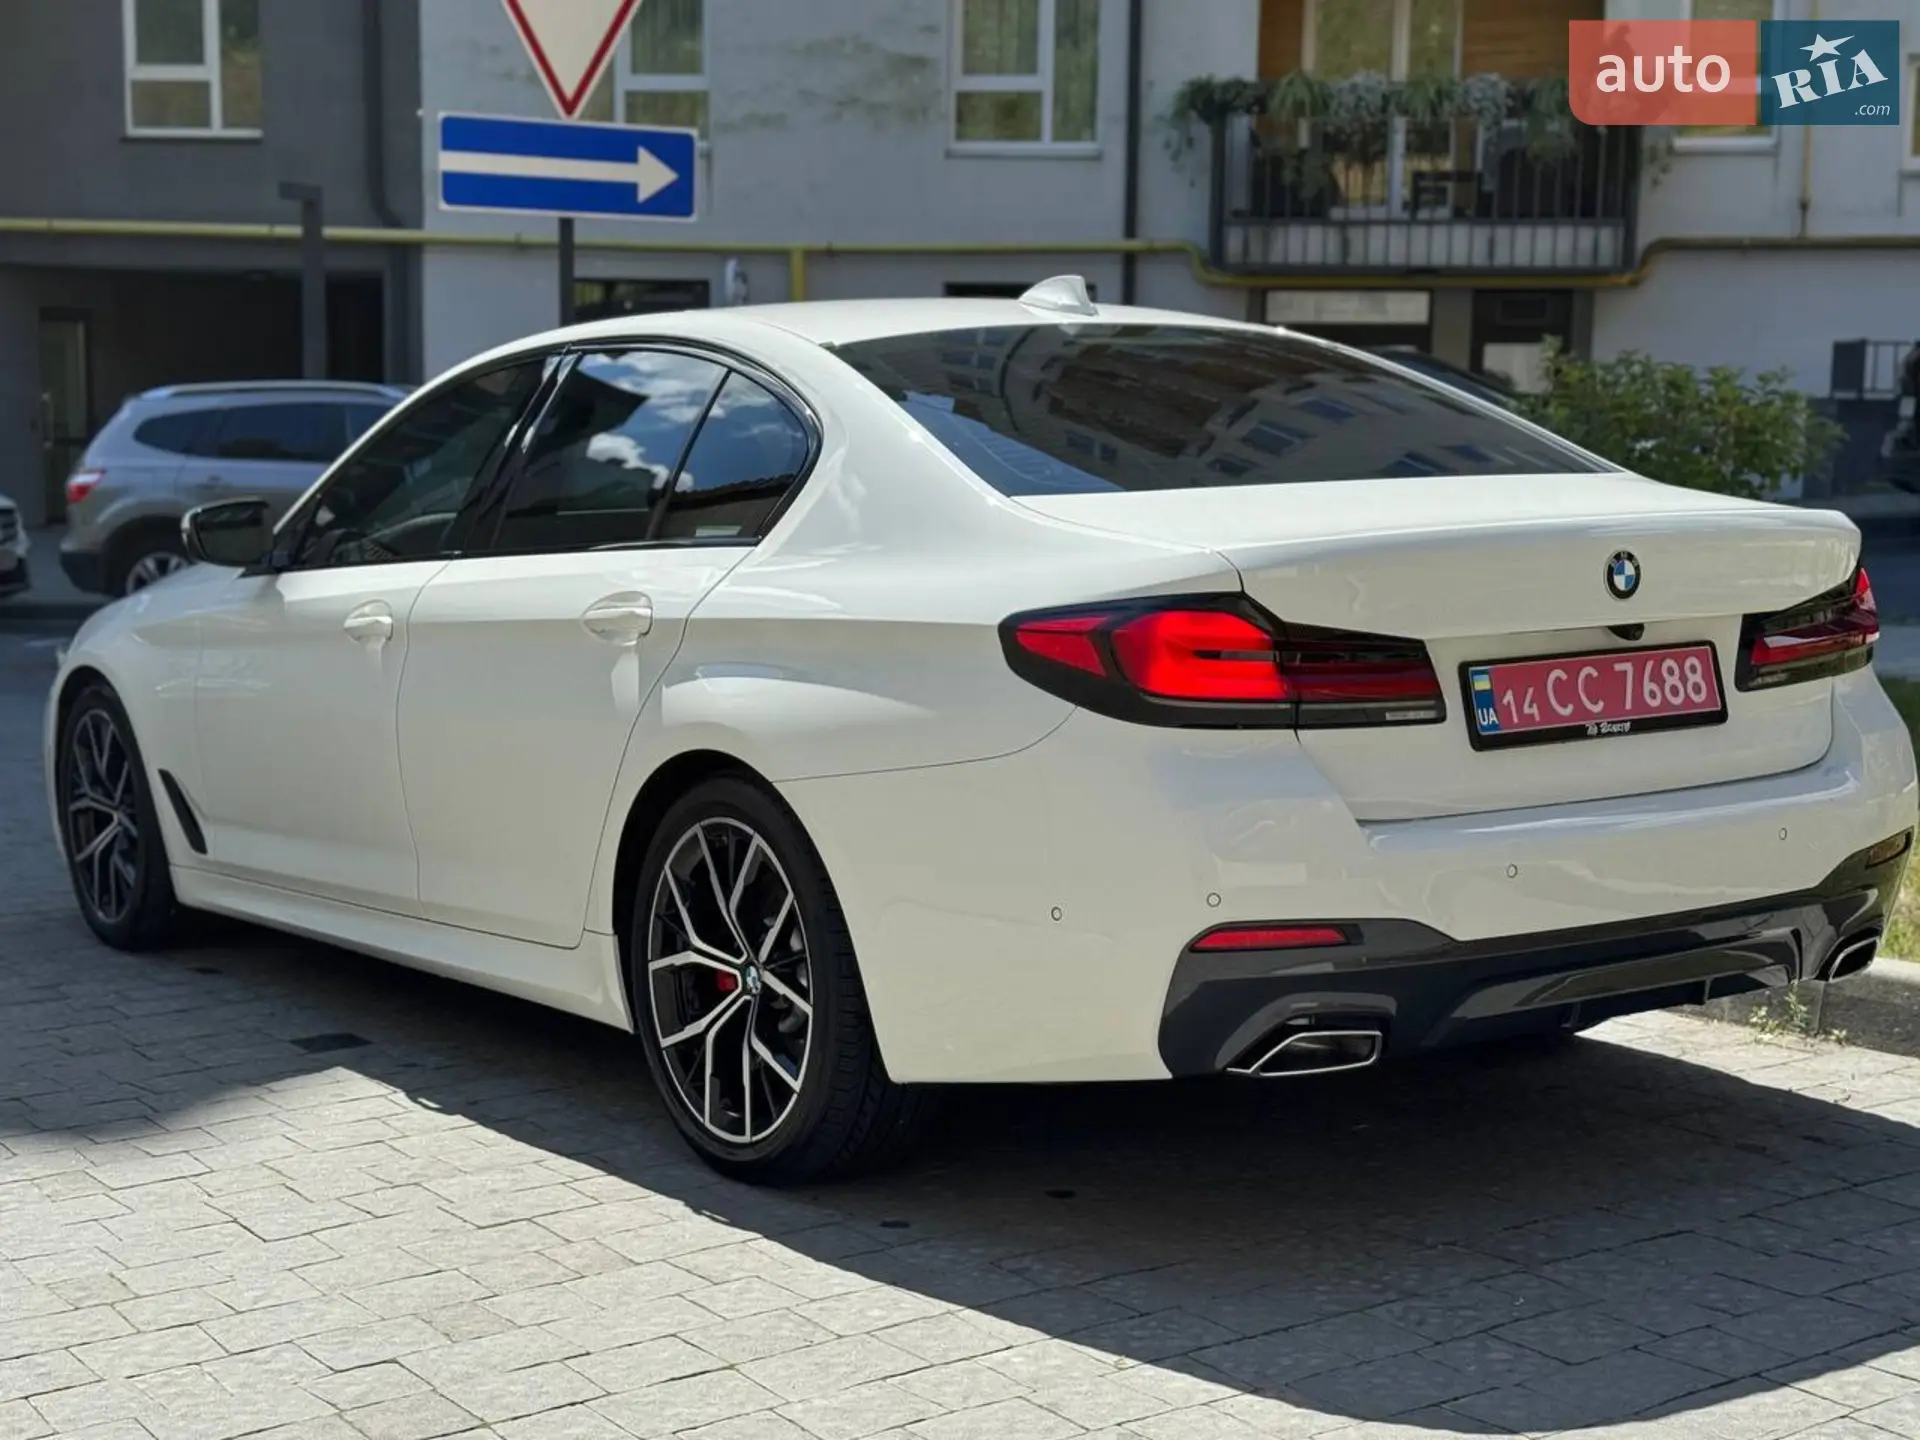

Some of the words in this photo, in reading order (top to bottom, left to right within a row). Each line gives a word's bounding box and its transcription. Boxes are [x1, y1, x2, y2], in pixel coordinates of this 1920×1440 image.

[1501, 686, 1541, 724] 14
[1546, 665, 1605, 717] CC
[1613, 655, 1708, 711] 7688
[1477, 707, 1499, 727] UA
